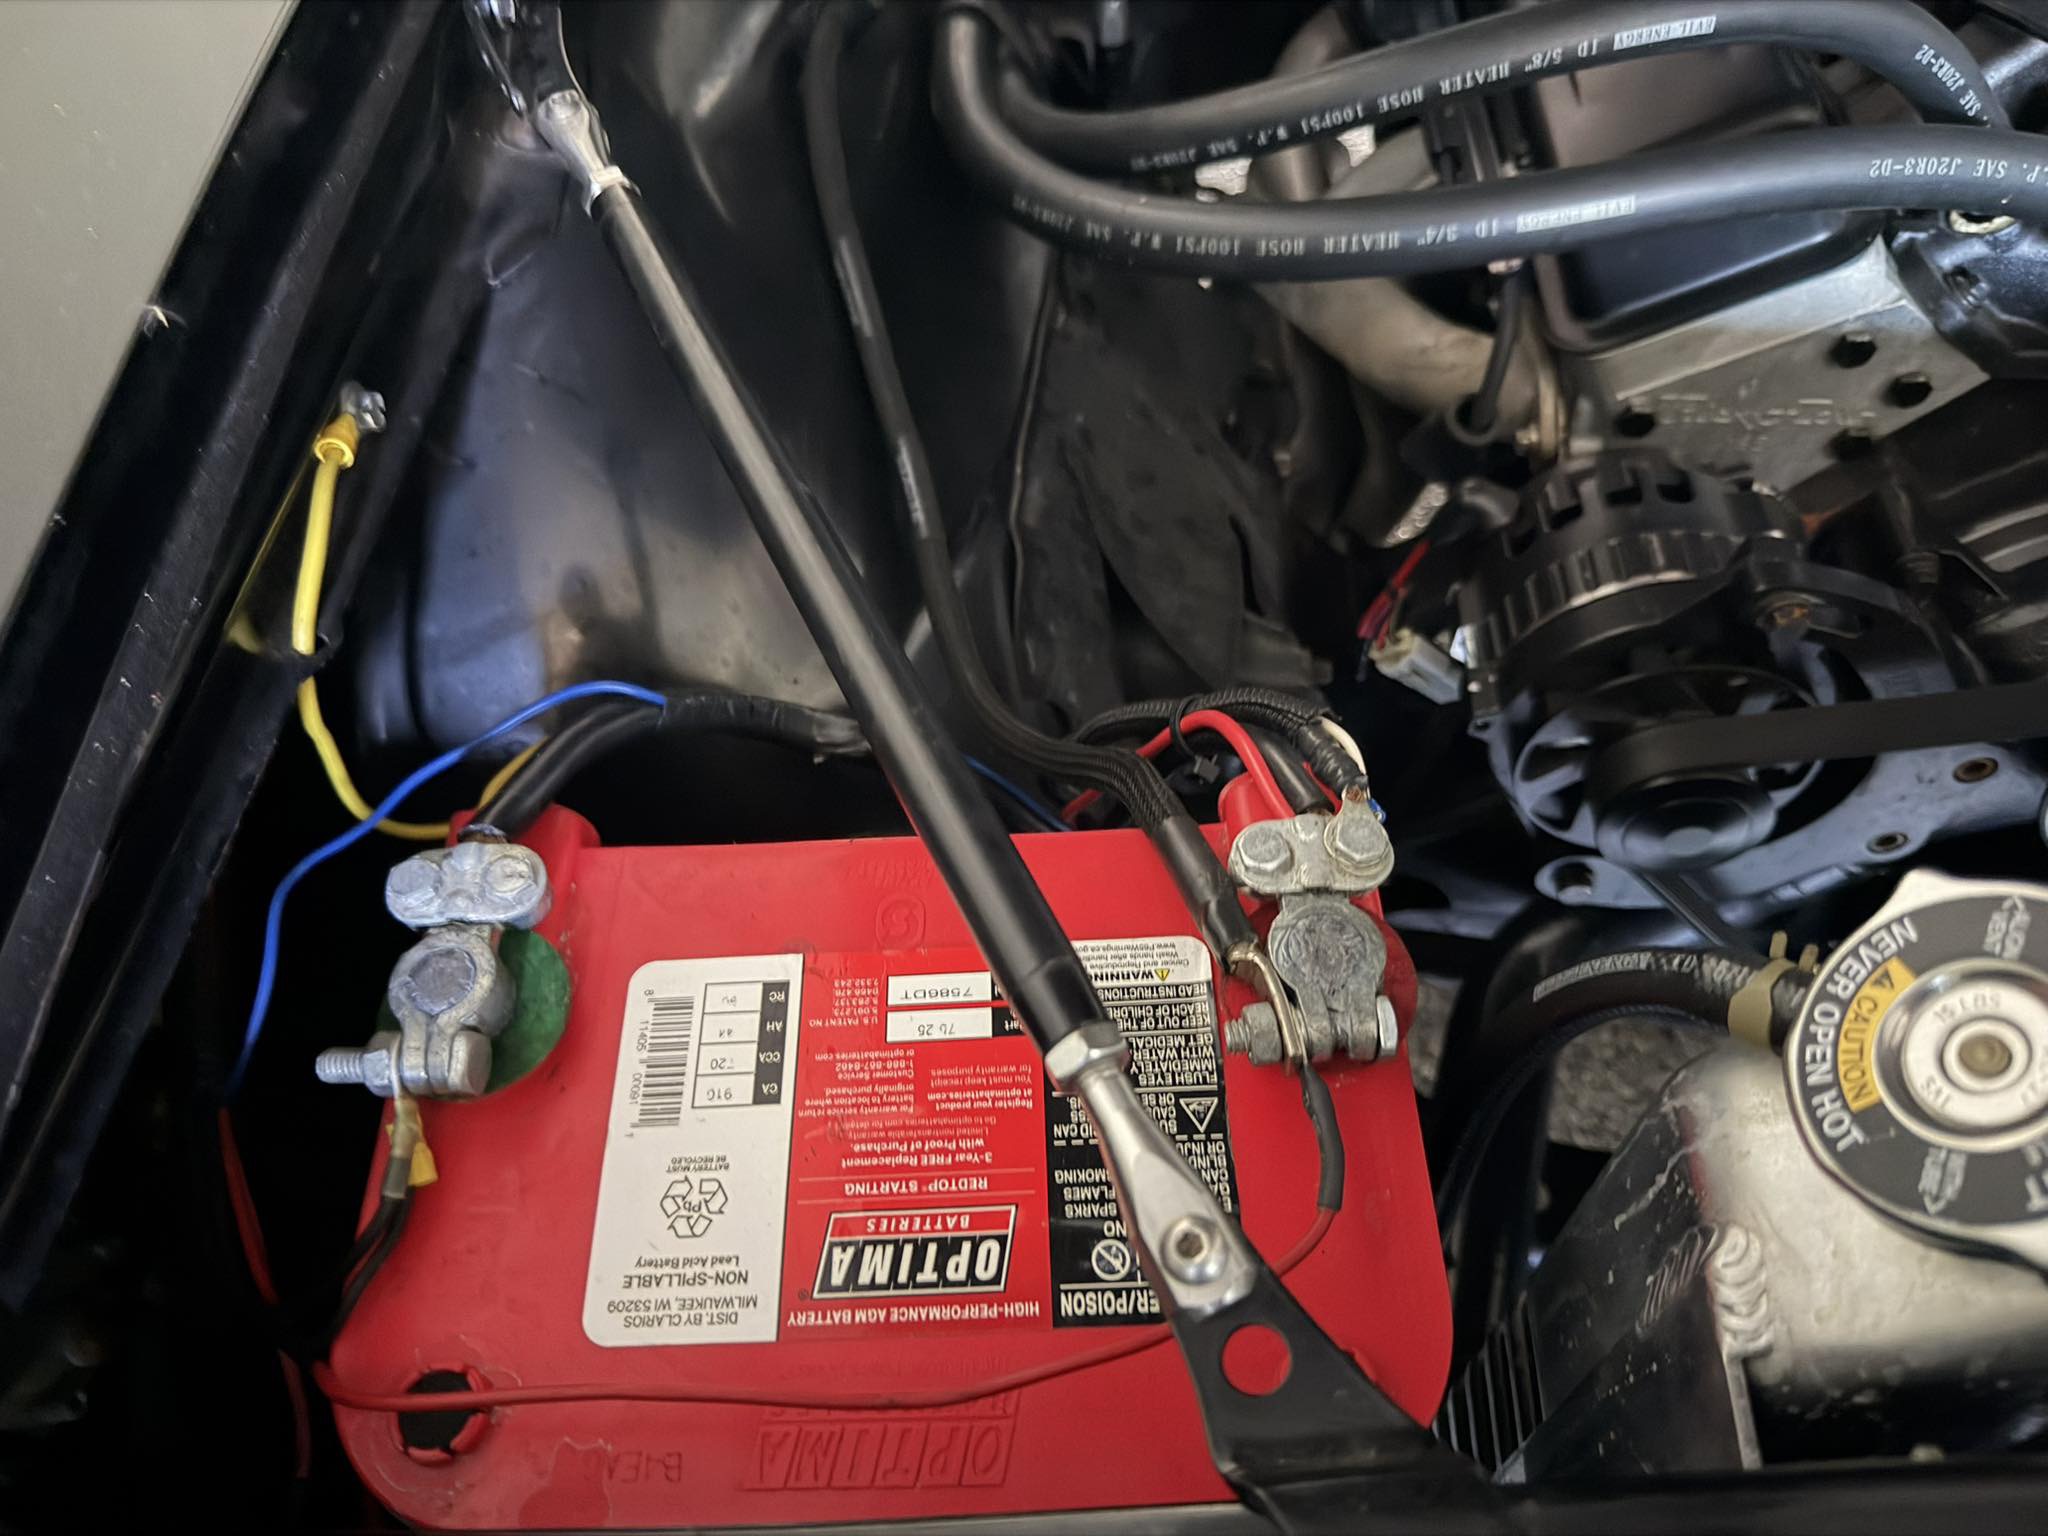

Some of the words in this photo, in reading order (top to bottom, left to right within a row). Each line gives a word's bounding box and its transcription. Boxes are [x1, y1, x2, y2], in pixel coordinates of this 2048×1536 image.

[1578, 39, 1600, 56] ID
[1524, 46, 1562, 72] 5/8"
[1914, 44, 1965, 91] J20R3-D2
[1439, 61, 1510, 95] HEATER
[1376, 86, 1424, 114] HOSE
[1959, 89, 1981, 116] SAE
[1301, 102, 1364, 135] 100PSI
[1869, 157, 1962, 177] J20R3-D2
[1973, 160, 2008, 179] SAE
[2023, 163, 2048, 184] .P.
[1475, 218, 1499, 236] ID
[1175, 236, 1240, 256] 100PSI
[1255, 238, 1306, 259] HOSE
[1324, 231, 1399, 253] HEATER
[1129, 952, 1154, 961] hands
[1826, 916, 1918, 1000] NEVER
[1143, 961, 1158, 970] and
[1160, 959, 1189, 968] Cancer
[768, 990, 785, 1001] RC
[900, 986, 973, 1000] 7586DT
[1097, 985, 1176, 1001] INSTRUCTIONS
[1178, 982, 1207, 997] READ
[1107, 1005, 1154, 1020] CHILDRE
[1155, 1003, 1169, 1017] OF
[1171, 1001, 1208, 1016] REACH
[766, 1020, 783, 1031] AH
[825, 1017, 859, 1027] PATENT
[1004, 1019, 1023, 1032] art
[1117, 1019, 1138, 1030] THE
[1140, 1017, 1155, 1029] OF
[1158, 1016, 1179, 1028] OUT
[1181, 1014, 1210, 1028] KEEP
[1128, 1035, 1185, 1049] MEDICAL
[1188, 1033, 1213, 1046] GET
[1805, 1001, 1841, 1087] OPEN
[906, 1049, 914, 1057] or
[1180, 1045, 1214, 1059] WITH
[1842, 994, 1879, 1104] CAUTION
[759, 1051, 781, 1063] CCA
[976, 1065, 1016, 1075] warranty
[1019, 1063, 1032, 1073] for
[1130, 1058, 1216, 1074] IMMEDIATELY
[838, 1072, 869, 1080] Service
[873, 1069, 914, 1078] Customer
[1015, 1074, 1032, 1085] You
[1175, 1071, 1217, 1085] FLUSH
[930, 1077, 963, 1088] receipt
[965, 1076, 987, 1086] keep
[989, 1076, 1013, 1085] must
[1138, 1075, 1172, 1086] EYES
[761, 1082, 778, 1095] CA
[875, 1082, 914, 1094] originally
[928, 1087, 1021, 1101] optimabatteries.com
[1024, 1088, 1032, 1097] at
[804, 1098, 832, 1107] where
[834, 1097, 869, 1105] location
[871, 1096, 880, 1104] to
[883, 1093, 914, 1103] battery
[973, 1099, 992, 1109] your
[995, 1098, 1033, 1110] Register
[827, 1107, 857, 1116] service
[860, 1104, 897, 1115] warranty
[900, 1104, 914, 1114] For
[935, 1100, 971, 1111] product
[798, 1109, 824, 1117] return
[871, 1120, 882, 1129] for
[974, 1117, 982, 1125] to
[983, 1116, 996, 1124] Go
[1812, 1089, 1866, 1153] HOT
[888, 1127, 955, 1138] nontransferable
[956, 1126, 989, 1136] Limited
[1054, 1124, 1078, 1138] CAN
[850, 1140, 907, 1154] Purchase.
[910, 1140, 922, 1151] of
[925, 1137, 957, 1150] Proof
[959, 1137, 984, 1149] with
[1176, 1142, 1204, 1157] INJU
[1207, 1141, 1225, 1155] OR
[671, 1155, 713, 1165] RECYCLED
[715, 1154, 727, 1164] BE
[841, 1154, 918, 1168] Replacement
[921, 1154, 952, 1165] FREE
[955, 1151, 992, 1165] 3-Year
[1188, 1154, 1226, 1170] BLIND
[666, 1164, 691, 1174] MUST
[694, 1161, 730, 1172] BATTERY
[844, 1180, 918, 1195] STARTING
[1064, 1185, 1115, 1201] FLAMES
[683, 1200, 702, 1213] Pb
[1065, 1202, 1117, 1218] SPARKS
[866, 1214, 969, 1232] BATTERIES
[1104, 1220, 1127, 1237] NO
[635, 1256, 679, 1269] Battery
[681, 1256, 709, 1268] Acid
[710, 1255, 740, 1267] Lead
[831, 1238, 1001, 1287] OPTIMA
[622, 1269, 749, 1289] NON-SPILLABLE
[607, 1300, 652, 1313] 53209
[654, 1299, 671, 1311] WI
[675, 1295, 758, 1310] MILWAUKEE,
[1061, 1289, 1160, 1316] ER/POISON
[854, 1306, 887, 1324] AGM
[890, 1300, 1040, 1321] HIGH-PERFORMANCE
[624, 1314, 684, 1328] CLARIOS
[684, 1312, 702, 1326] BY
[706, 1311, 738, 1325] DIST.
[787, 1309, 851, 1326] BATTERY
[759, 1424, 1001, 1485] OPTIMA
